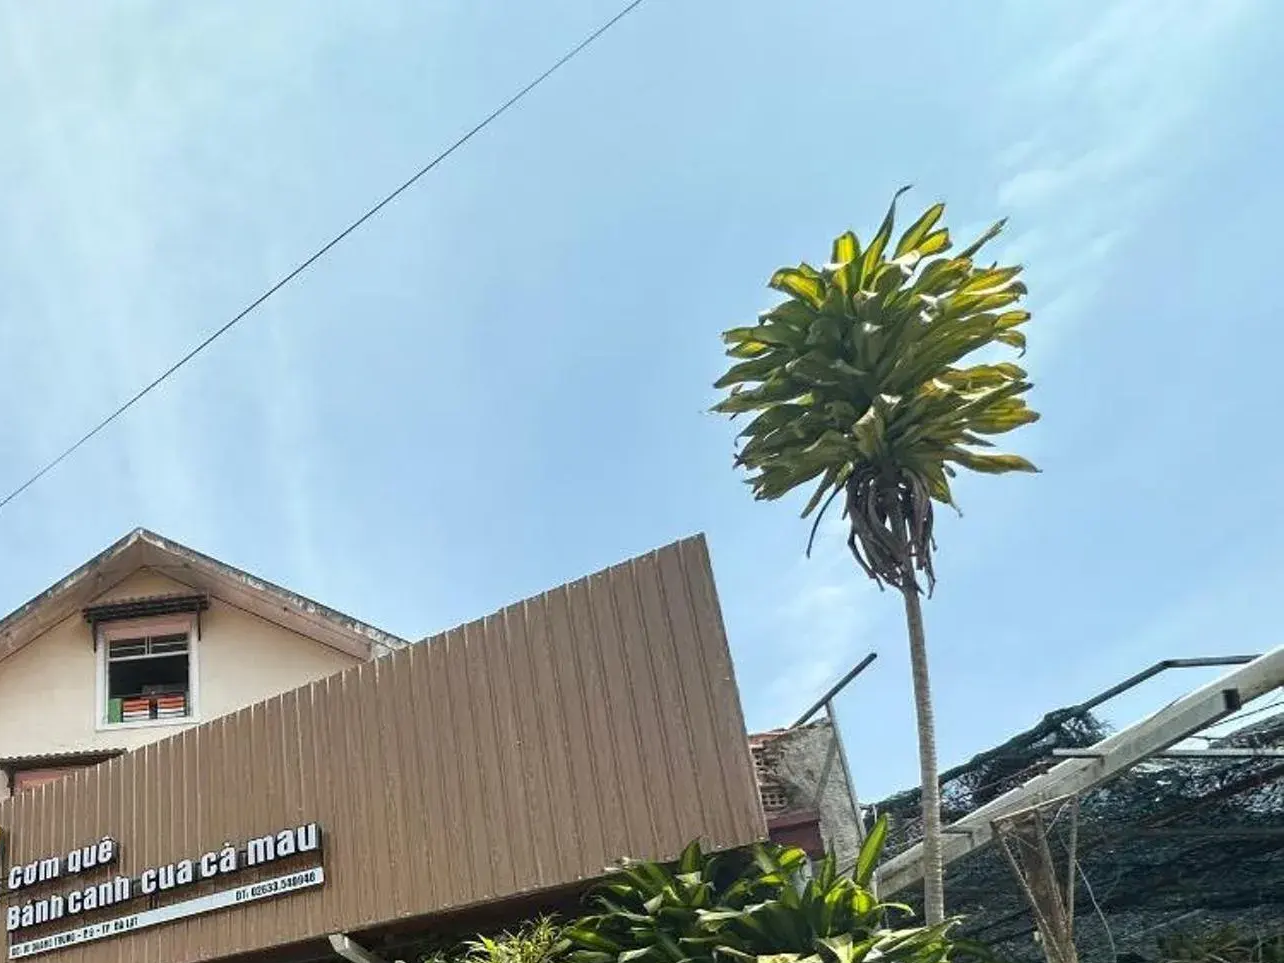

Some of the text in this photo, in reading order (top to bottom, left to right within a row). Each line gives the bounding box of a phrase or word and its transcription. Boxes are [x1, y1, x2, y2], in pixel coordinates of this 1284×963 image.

[67, 836, 115, 872] quê
[7, 894, 63, 932] Bánh
[68, 874, 131, 914] canh
[141, 859, 193, 894] cua
